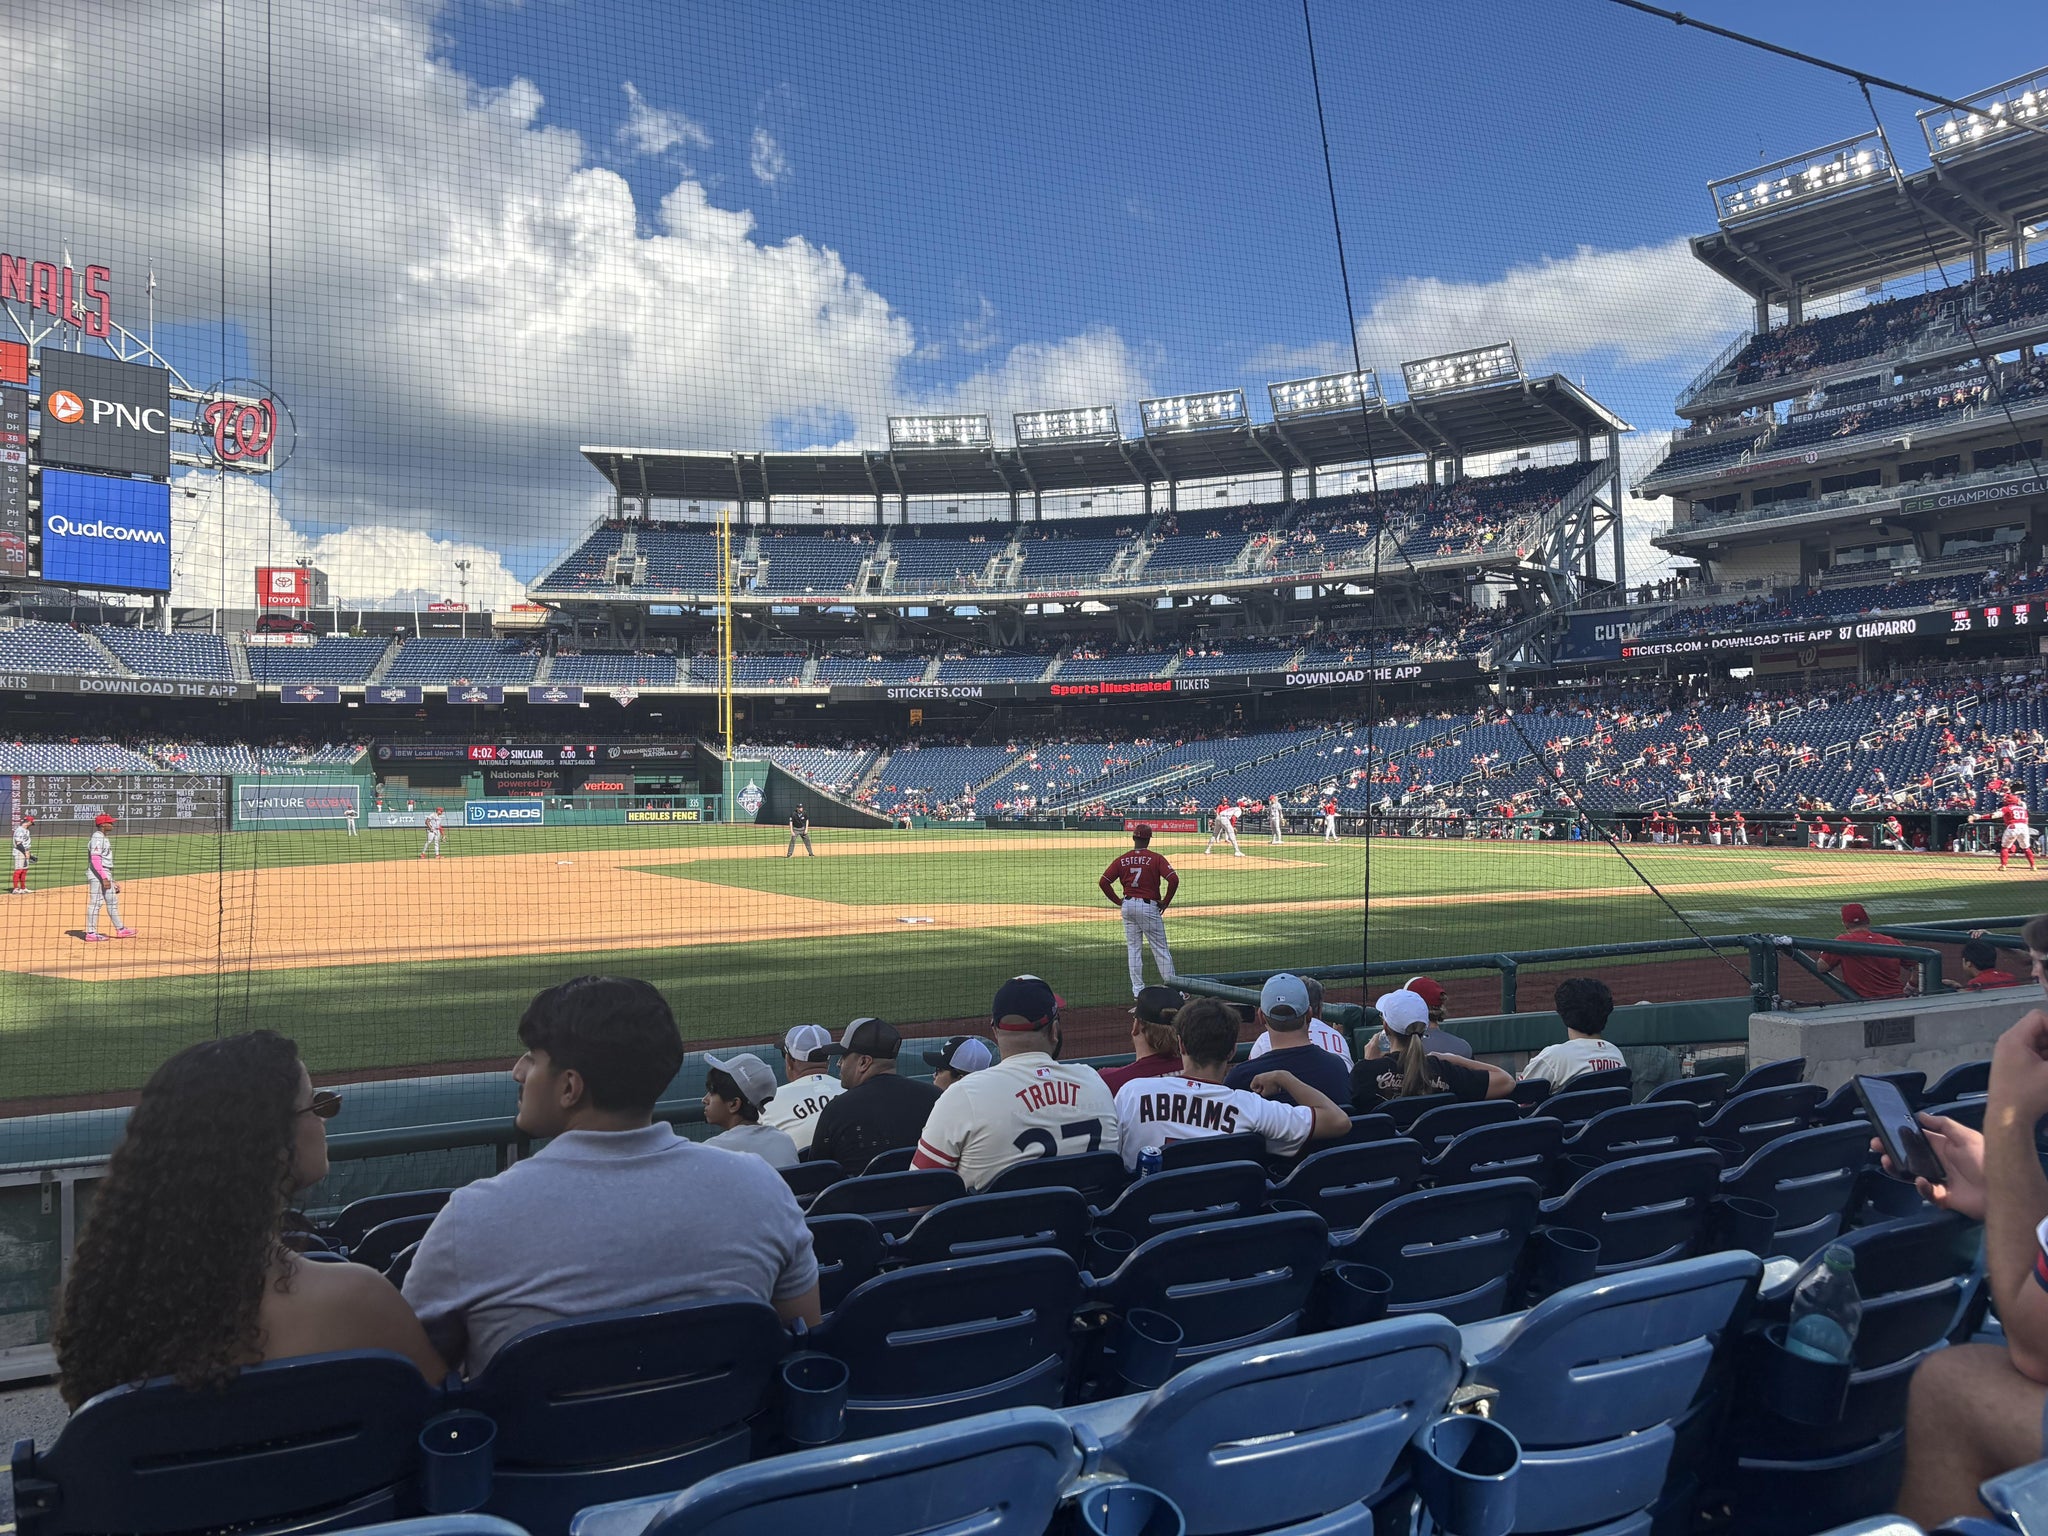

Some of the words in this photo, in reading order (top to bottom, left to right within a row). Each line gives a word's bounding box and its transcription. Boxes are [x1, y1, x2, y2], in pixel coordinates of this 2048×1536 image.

[1, 253, 110, 338] NALS
[1792, 413, 1813, 424] NEED
[1814, 402, 1866, 419] ASSISTANCE?
[1920, 388, 1931, 397] TO
[7, 412, 19, 420] RF
[89, 398, 166, 434] PNC
[6, 423, 20, 431] DH
[1938, 484, 2018, 507] CHAMPIONS
[47, 514, 166, 545] Qualcomm
[268, 596, 301, 604] TOYOTA
[1950, 618, 1971, 632] .253
[1986, 615, 1999, 628] 10
[2014, 612, 2028, 625] 36
[1839, 627, 1852, 640] 87
[1855, 619, 1916, 639] CHAPARRO
[1622, 642, 1701, 657] SITICKETS.COM
[1711, 634, 1780, 648] DOWNLOAD
[1782, 631, 1805, 643] THE
[1808, 629, 1832, 642] APP
[1286, 671, 1364, 686] DOWNLOAD
[1394, 666, 1422, 679] APP
[0, 676, 28, 689] KETS
[79, 679, 174, 695] DOWNLOAD
[177, 683, 205, 696] THE
[209, 685, 238, 697] APP
[1051, 683, 1099, 696] Sports
[1174, 678, 1210, 691] TICKETS
[887, 687, 982, 699] SITICKETS.COM
[472, 747, 493, 759] 4:02
[511, 749, 544, 759] SINCLAIR
[560, 751, 576, 759] 0.00
[589, 751, 594, 759] 4
[622, 747, 665, 755] WASHINGTON
[643, 749, 679, 758] NATIONALS
[490, 770, 535, 779] Nationals
[537, 770, 560, 779] Park
[497, 780, 540, 789] powered
[540, 780, 552, 789] by
[583, 781, 624, 791] verizon
[247, 797, 304, 808] VENTURE
[689, 798, 699, 808] 335
[130, 807, 143, 815] 7:20
[487, 809, 541, 819] DABOS
[628, 811, 671, 821] HERCULES
[672, 811, 698, 821] FENCE
[1120, 856, 1152, 867] ESTEVEZ
[1129, 867, 1142, 887] 7
[1015, 1080, 1081, 1113] TROUT
[1140, 1093, 1240, 1134] ABRAMS
